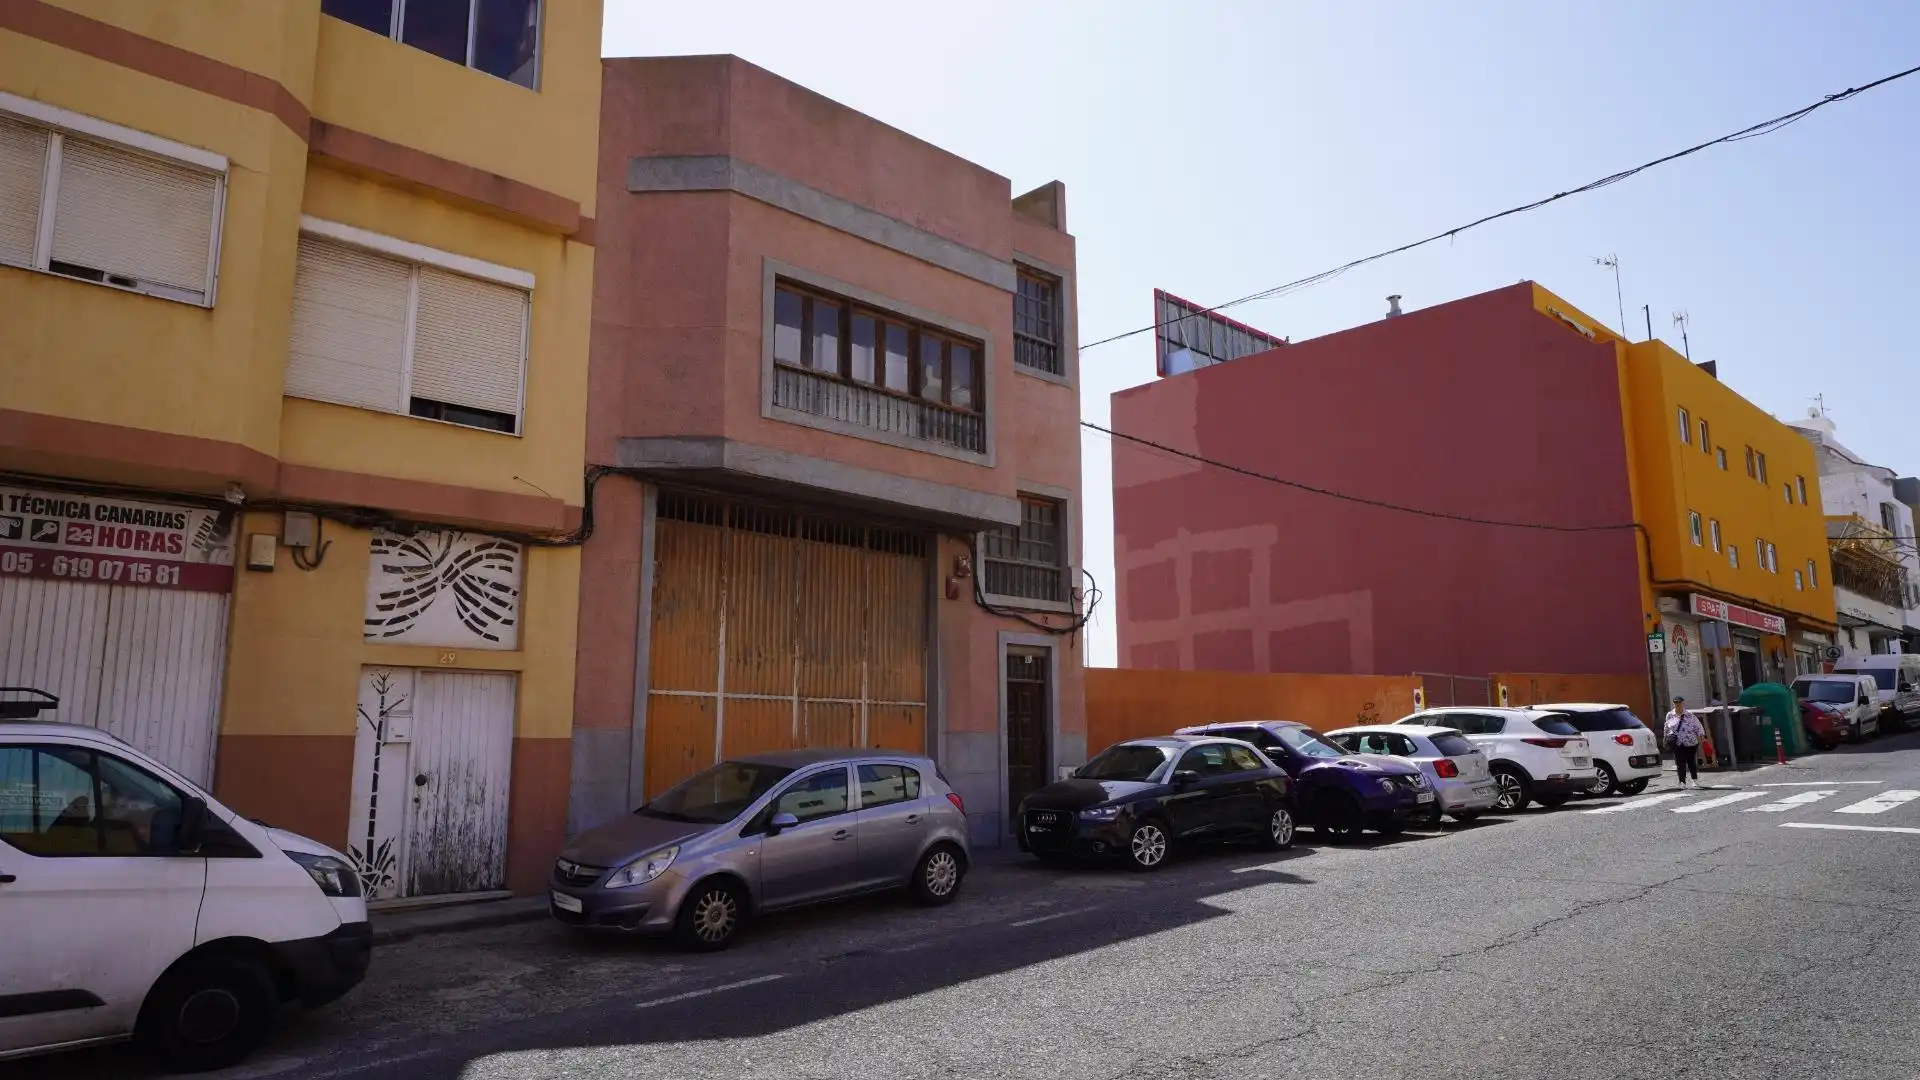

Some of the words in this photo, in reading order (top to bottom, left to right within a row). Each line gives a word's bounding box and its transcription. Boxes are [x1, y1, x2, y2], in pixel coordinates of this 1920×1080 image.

[9, 494, 91, 520] TÉCNICA
[95, 504, 185, 530] CANARIAS
[66, 526, 93, 544] 24
[97, 526, 183, 555] HORAS
[1, 552, 33, 574] 05
[53, 555, 93, 578] 619
[98, 560, 124, 581] 07
[127, 562, 152, 583] 15
[155, 564, 180, 585] 81
[1701, 600, 1721, 615] SPAR
